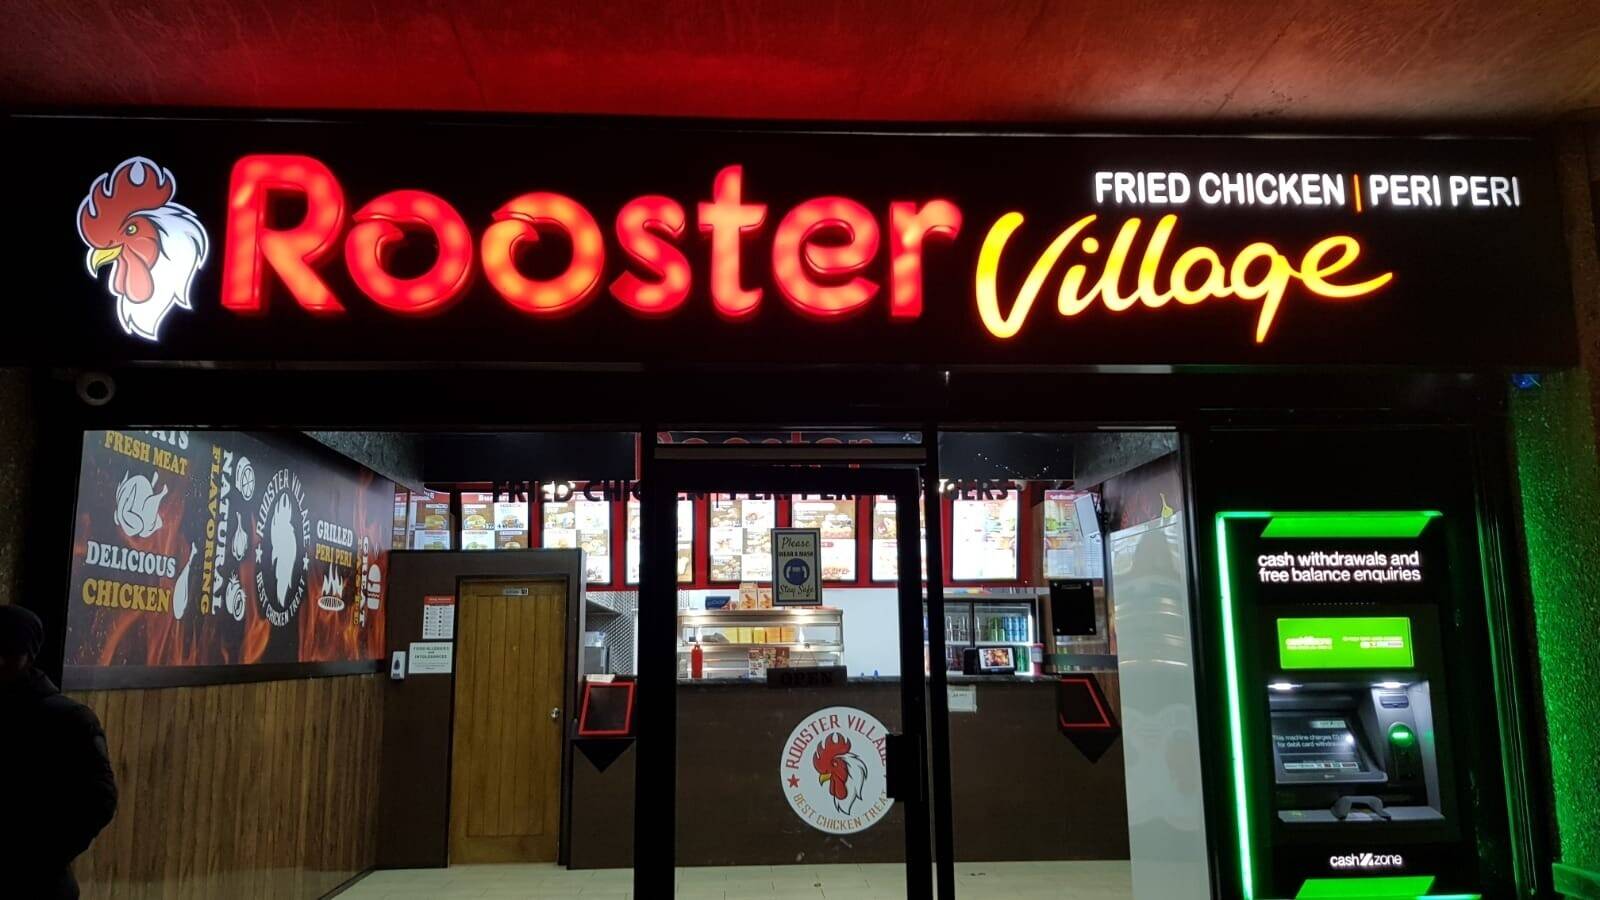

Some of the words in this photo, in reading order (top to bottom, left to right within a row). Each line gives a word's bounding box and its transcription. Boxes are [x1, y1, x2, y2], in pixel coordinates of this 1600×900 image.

[1095, 172, 1191, 204] FRIED
[1199, 173, 1345, 206] CHICKEN
[1369, 174, 1441, 207] PERI
[1450, 175, 1520, 207] PERI
[221, 154, 962, 317] Rooster
[975, 212, 1393, 342] Village
[104, 431, 150, 463] FRESH
[152, 448, 188, 476] MEAT
[256, 468, 289, 538] ROOSTER
[291, 472, 311, 548] VILLAGE
[200, 444, 221, 616] FLAVORING
[212, 450, 234, 616] NATURAL
[317, 519, 353, 548] GRILLED
[782, 536, 810, 549] Please
[85, 540, 176, 578] DELICIOUS
[315, 543, 334, 563] PERI
[335, 546, 353, 568] PERI
[1258, 551, 1295, 567] cash
[1297, 550, 1387, 567] withdrawals
[1390, 550, 1420, 566] and
[1258, 567, 1290, 582] free
[1291, 567, 1350, 582] balance
[1353, 566, 1422, 584] enquiries
[82, 578, 171, 613] CHICKEN
[256, 571, 267, 608] BEST
[265, 603, 289, 627] CHICKEN
[289, 575, 306, 617] TREAT
[781, 671, 833, 686] OPEN
[786, 714, 840, 769] ROOSTER
[793, 793, 816, 819] BEST
[816, 814, 862, 831] CHICKEN
[1330, 853, 1360, 866] cash
